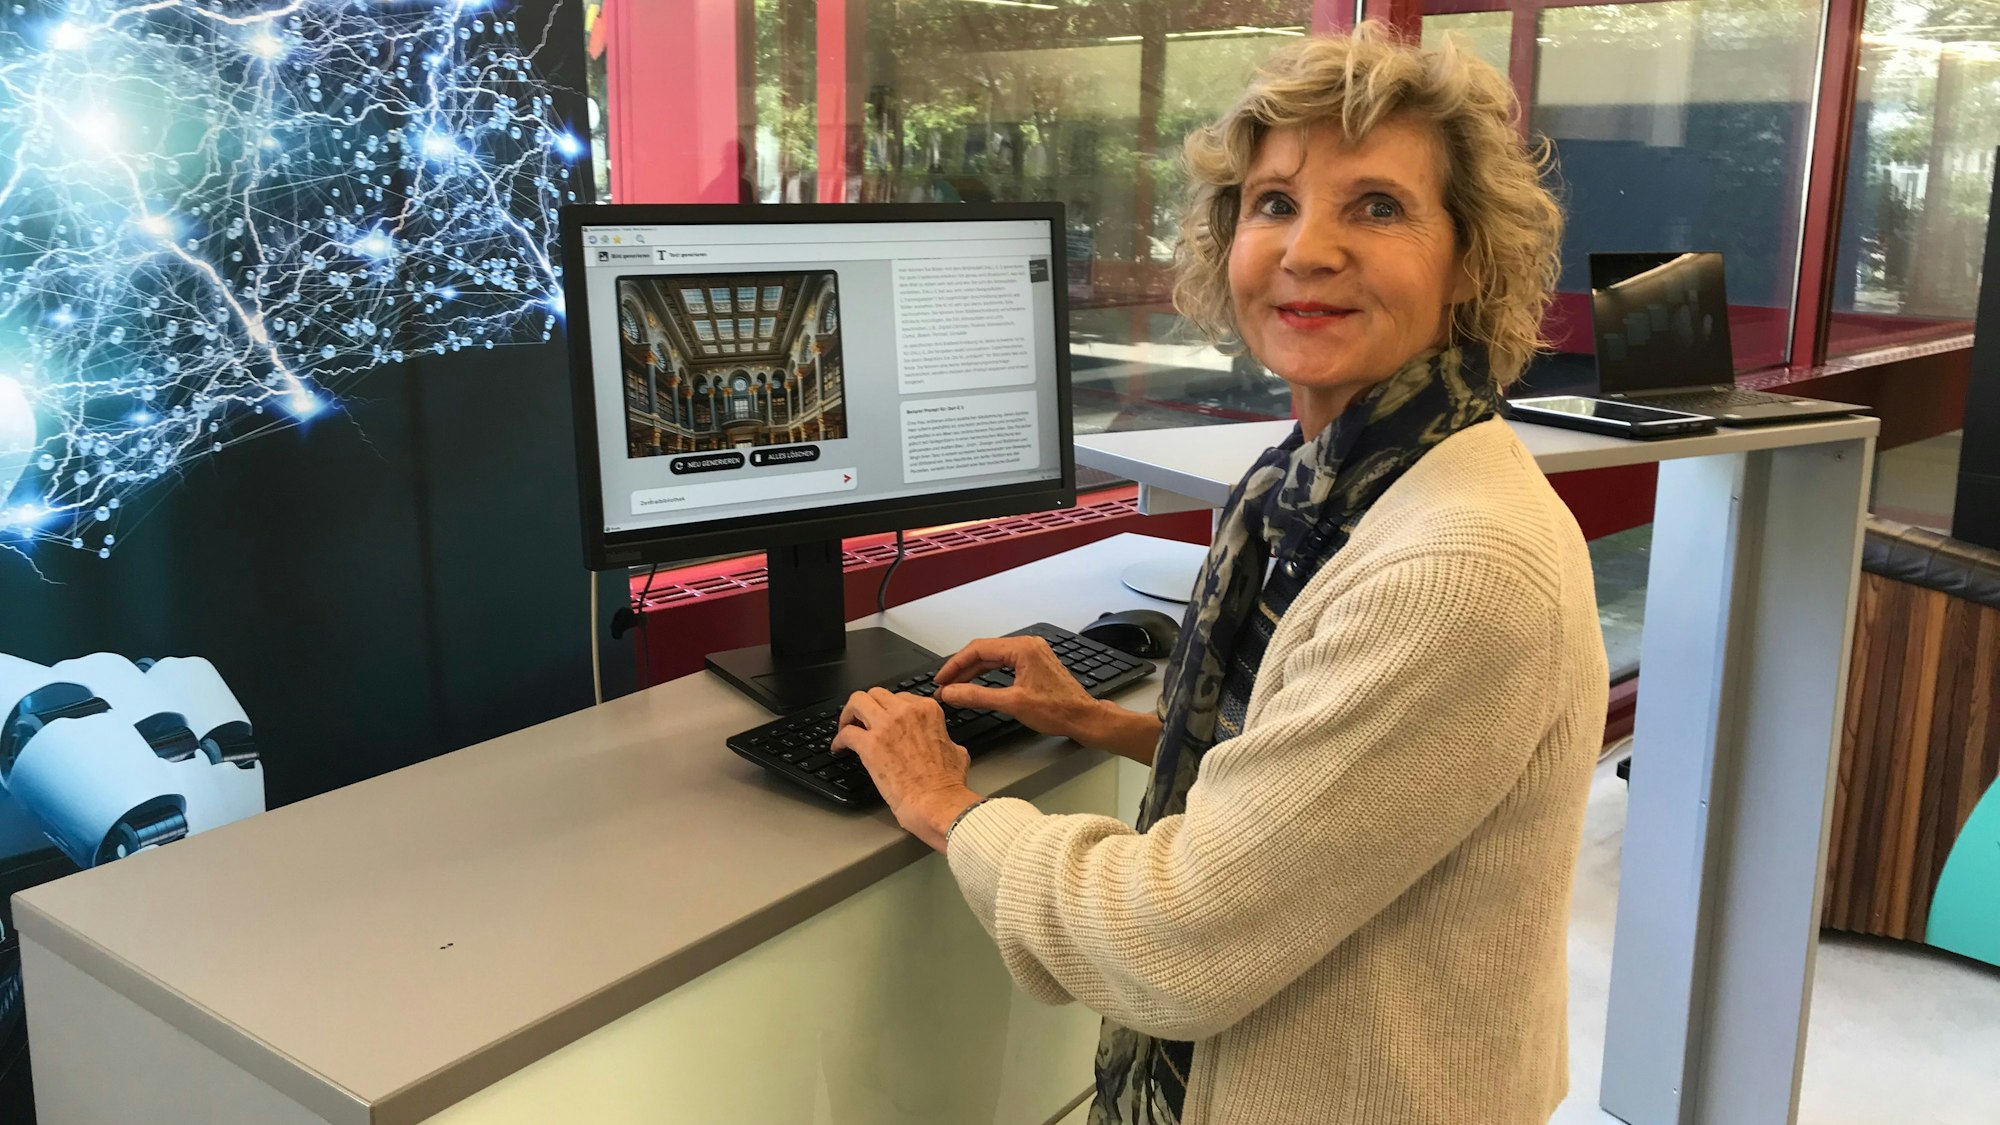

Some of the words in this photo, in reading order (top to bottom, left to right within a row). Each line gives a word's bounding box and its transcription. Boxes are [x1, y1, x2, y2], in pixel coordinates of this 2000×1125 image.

[768, 452, 786, 461] ALLES
[787, 449, 814, 459] LÖSCHEN
[687, 461, 701, 469] NEU
[701, 457, 741, 468] GENERIEREN
